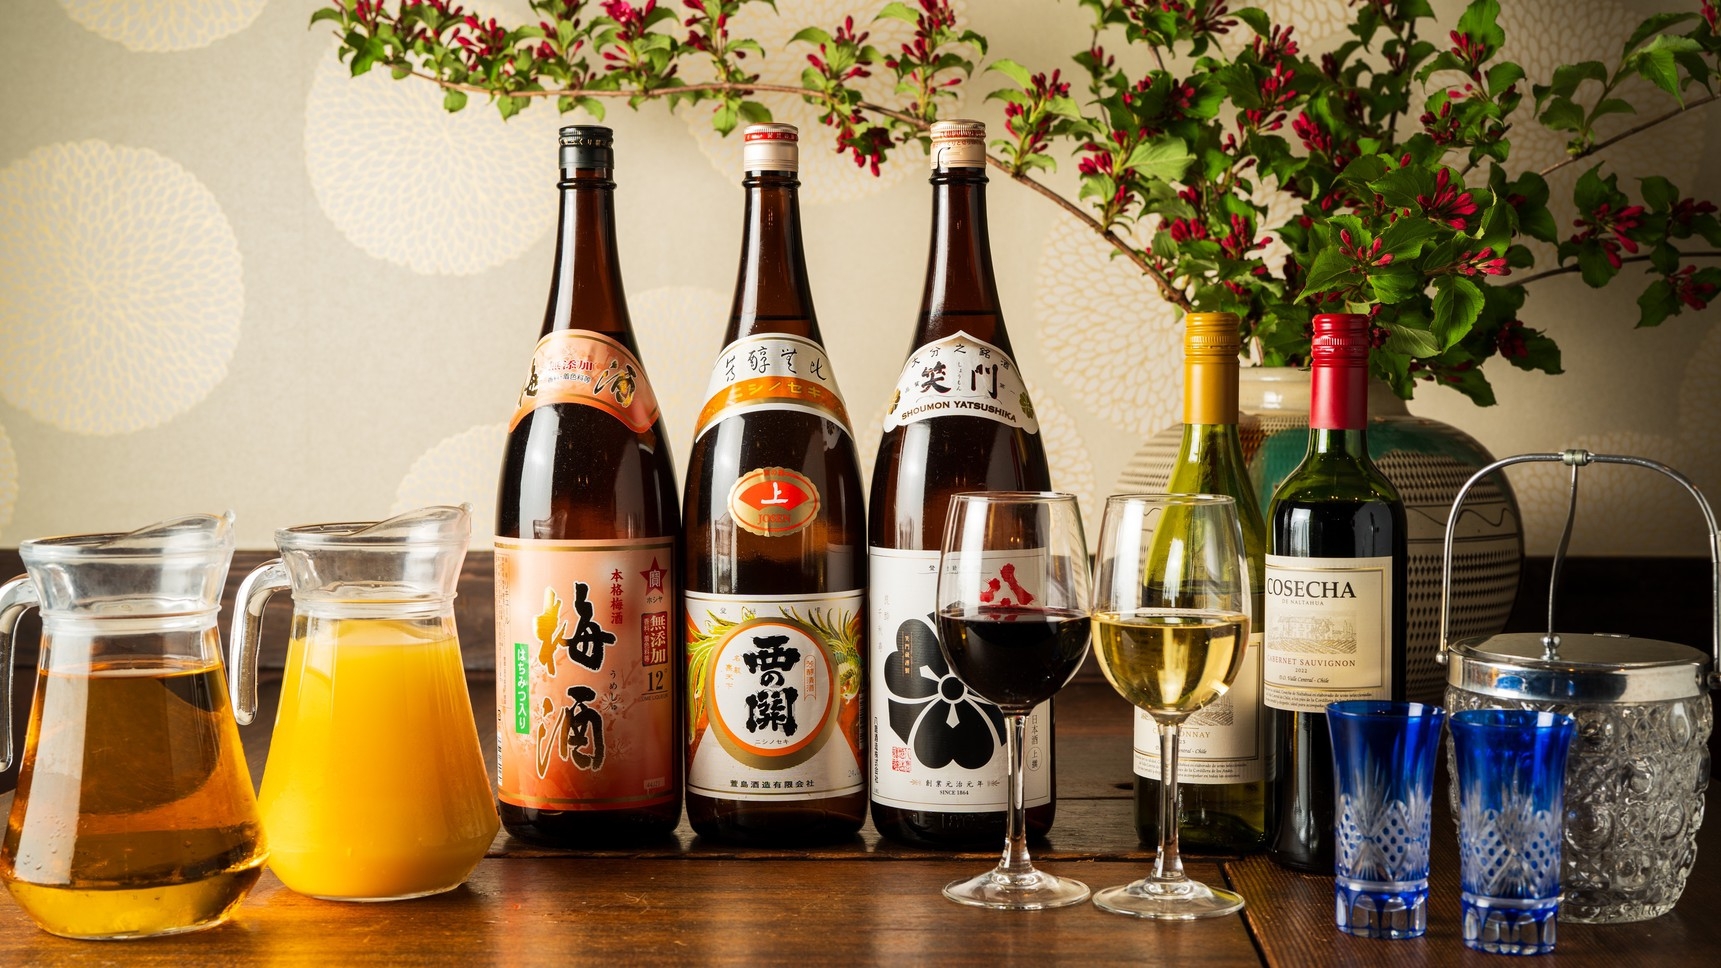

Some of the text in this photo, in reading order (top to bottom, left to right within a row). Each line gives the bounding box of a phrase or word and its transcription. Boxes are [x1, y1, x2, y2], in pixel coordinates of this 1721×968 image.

[732, 382, 822, 399] ニシノセキ
[902, 400, 1017, 422] SHOUMON YATSUSHIKA
[760, 482, 788, 504] 上
[758, 514, 791, 524] JOSEN
[611, 568, 624, 624] 本格梅酒
[1267, 578, 1356, 598] COSECHA
[650, 615, 666, 664] 無添加
[1266, 655, 1296, 664] CABERNET
[518, 648, 528, 730] はちみつ入り
[1153, 728, 1210, 738] CONNAY
[730, 780, 814, 788] 萱島酒造有限会社
[926, 780, 984, 788] 創業元治元年
